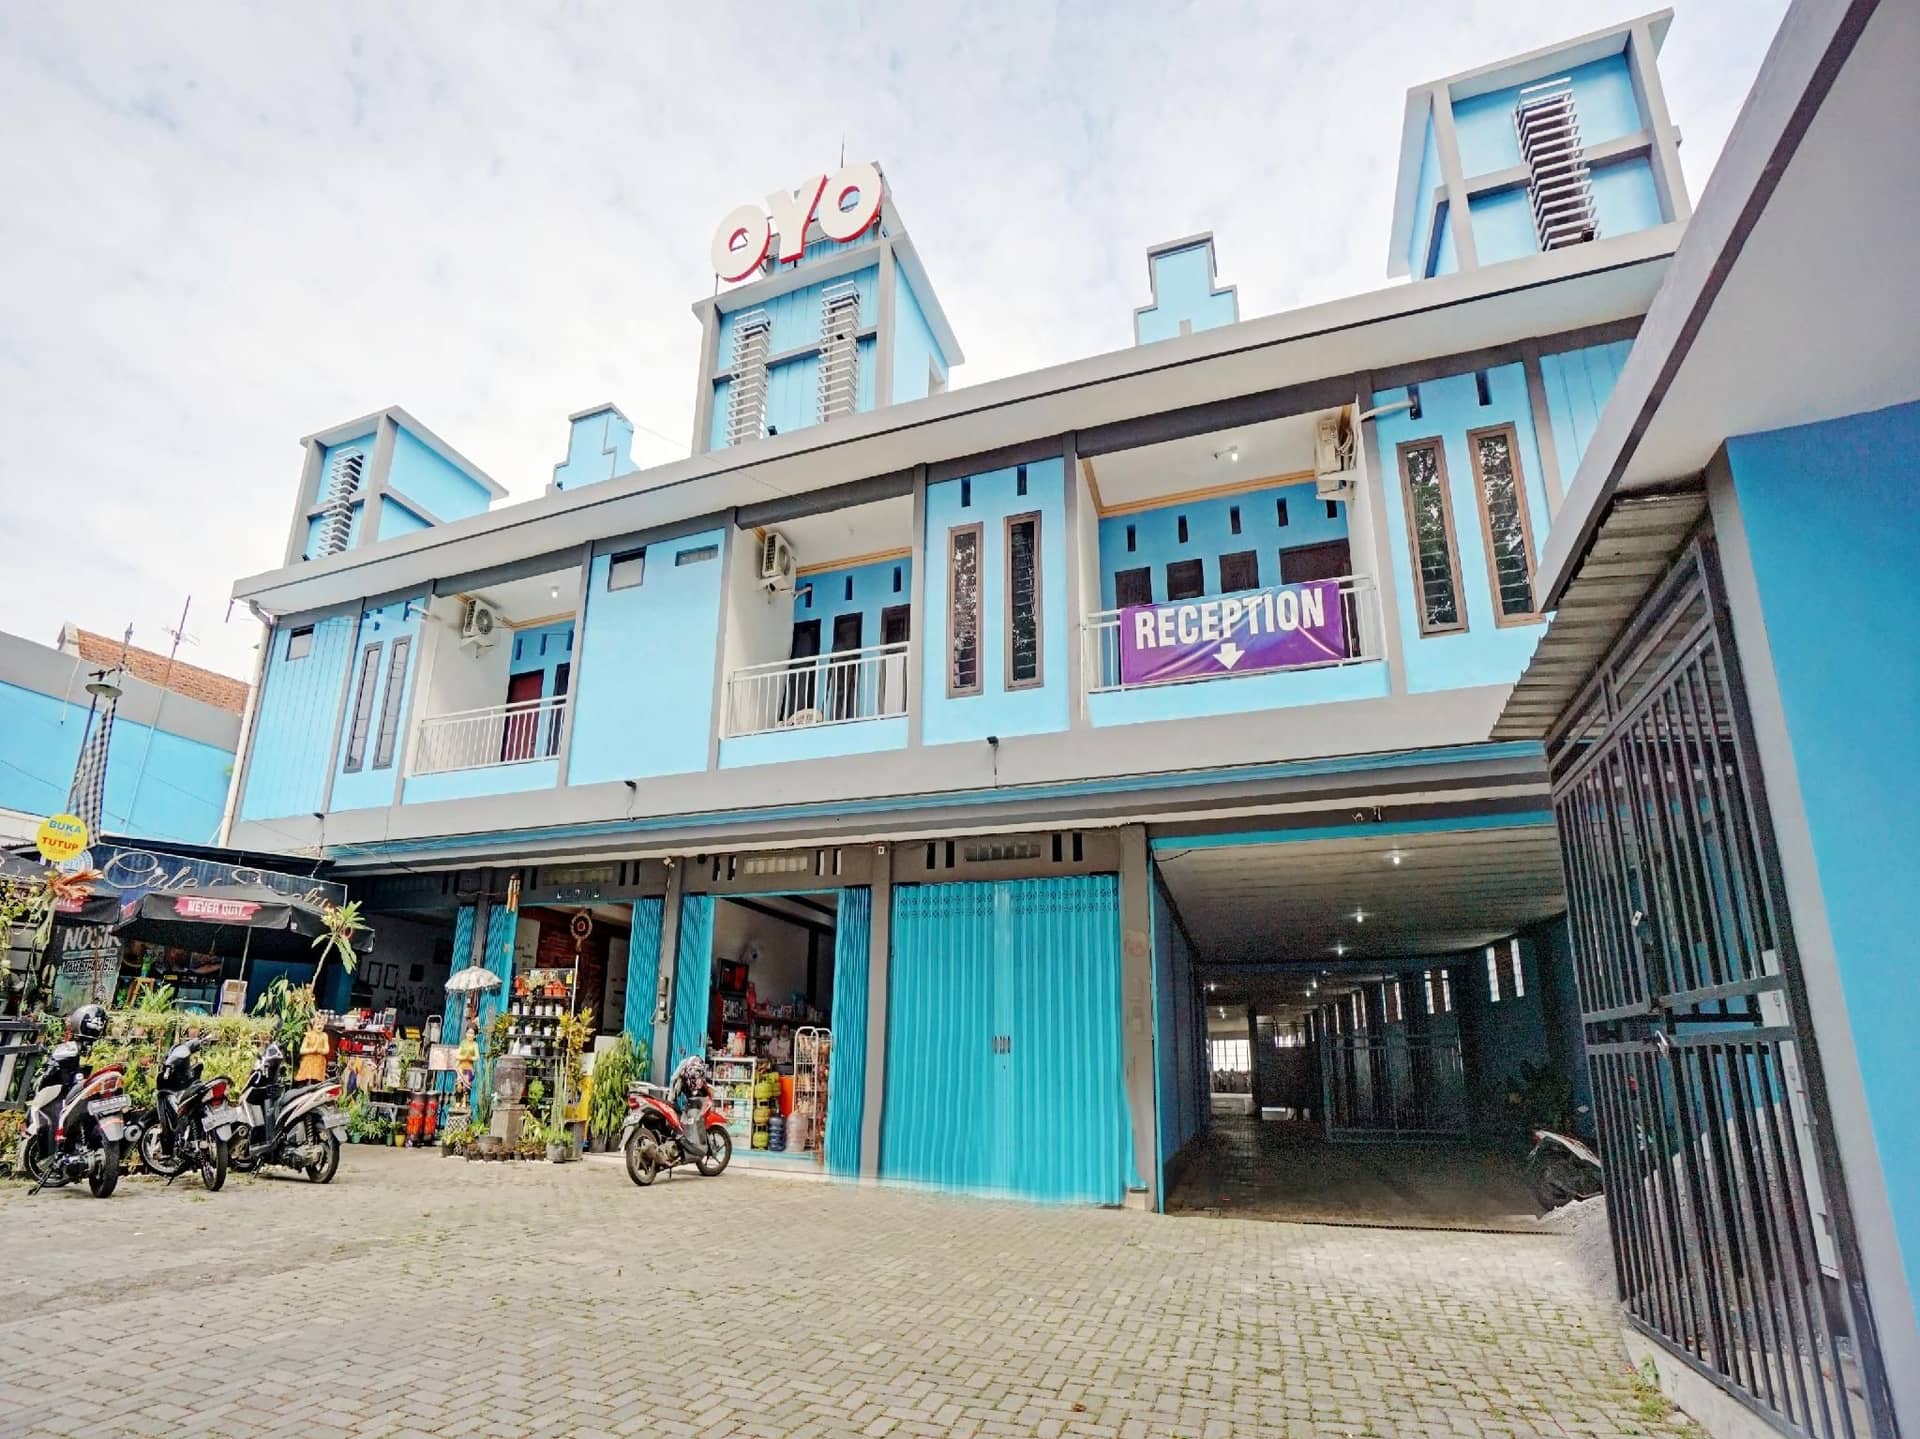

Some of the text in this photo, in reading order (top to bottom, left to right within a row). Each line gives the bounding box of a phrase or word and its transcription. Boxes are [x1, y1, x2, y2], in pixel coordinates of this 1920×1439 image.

[711, 162, 883, 282] OYO
[1134, 588, 1325, 650] RECEPTION
[48, 820, 81, 833] BUKA
[42, 837, 79, 851] TUTUP
[187, 900, 219, 914] NEVER
